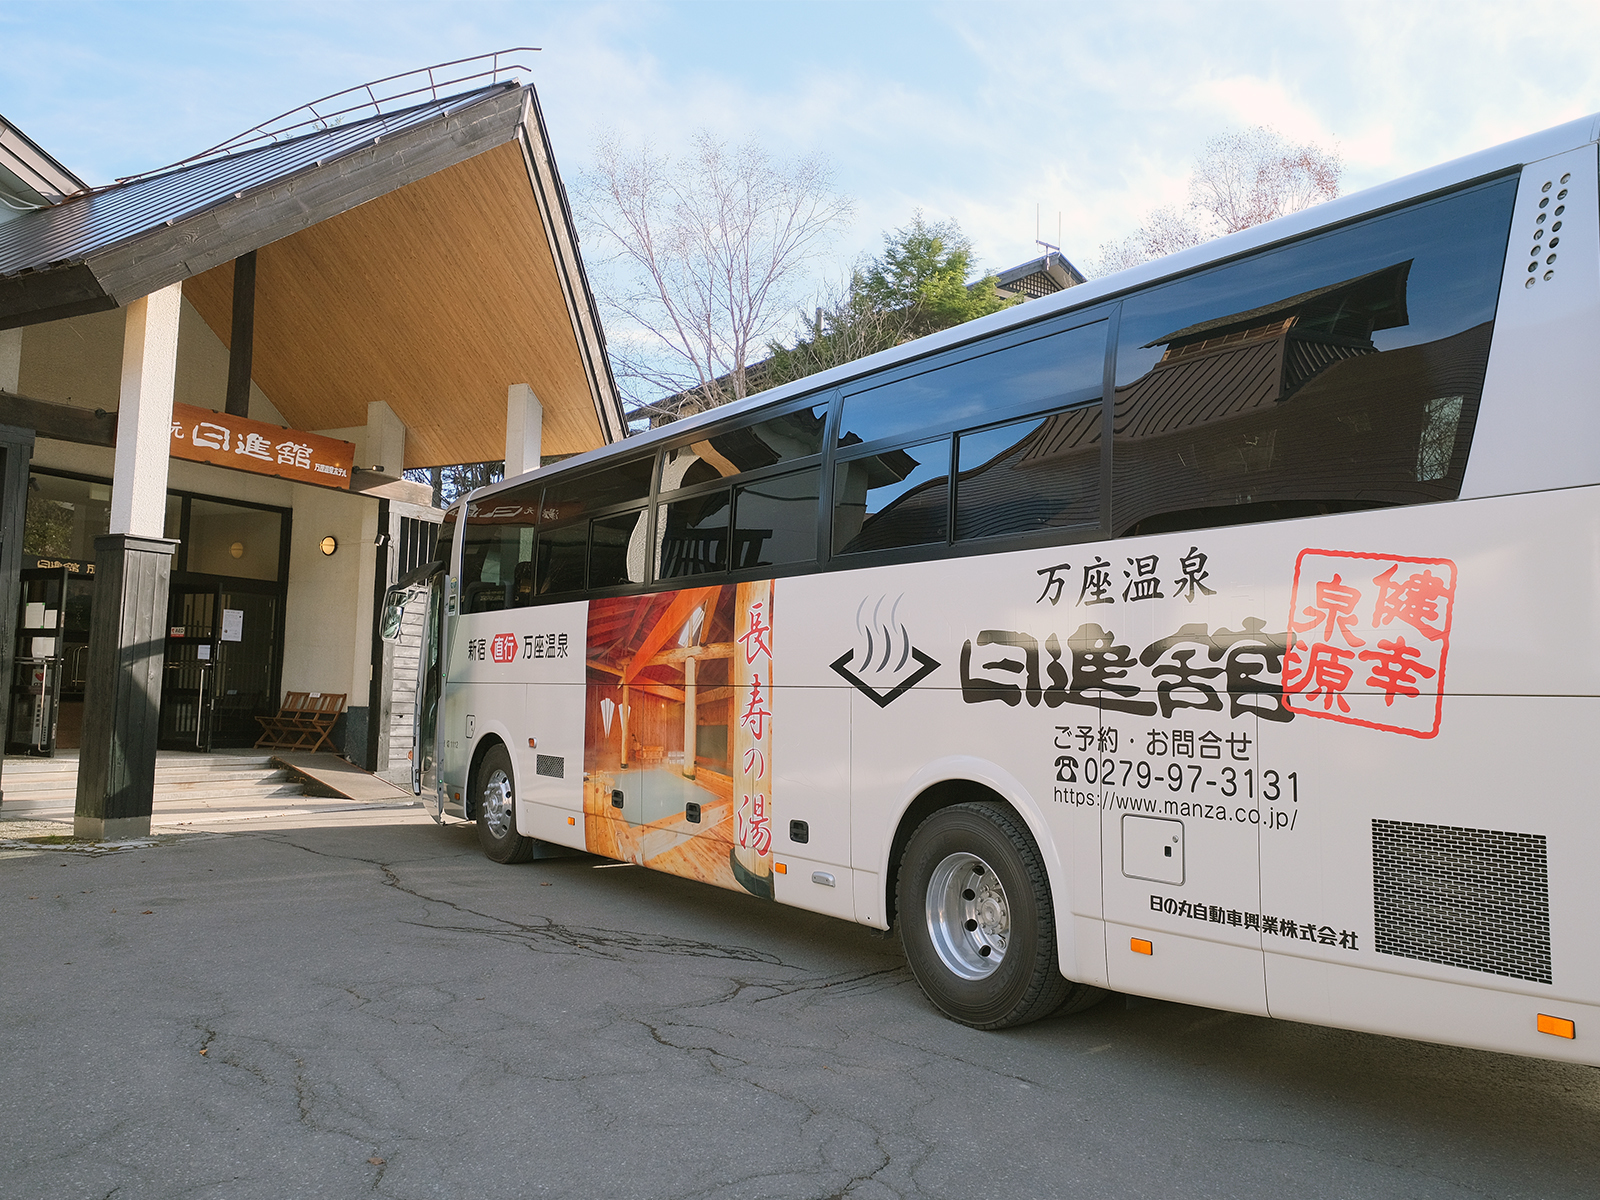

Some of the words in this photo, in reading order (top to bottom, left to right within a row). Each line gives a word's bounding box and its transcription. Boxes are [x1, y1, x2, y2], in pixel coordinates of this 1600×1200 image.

[192, 422, 314, 470] 日進館
[1035, 546, 1218, 607] 万座温泉
[467, 638, 487, 661] 新宿
[494, 636, 515, 660] 直行
[522, 632, 569, 660] 万座温泉
[960, 616, 1297, 723] 日進館
[737, 602, 773, 857] 長寿の湯
[1084, 757, 1298, 803] 0279-97-3131
[1053, 786, 1299, 831] https://www.manza.co.jp/
[1150, 894, 1360, 951] 日の丸自動車興業株式会社
